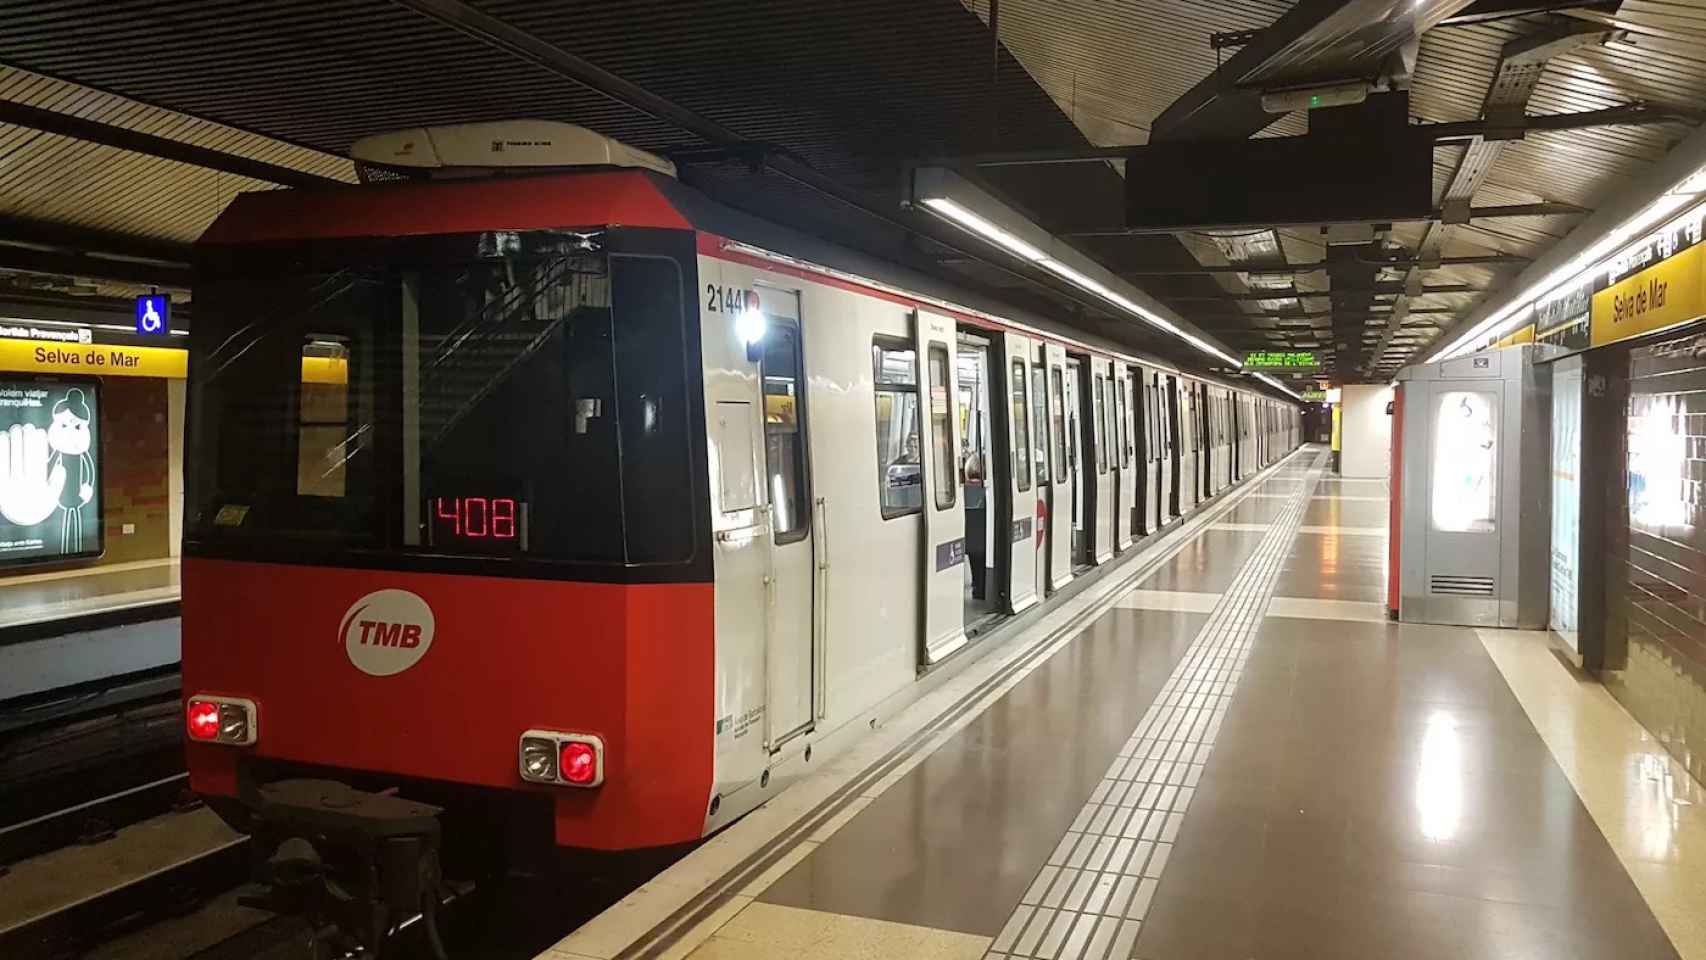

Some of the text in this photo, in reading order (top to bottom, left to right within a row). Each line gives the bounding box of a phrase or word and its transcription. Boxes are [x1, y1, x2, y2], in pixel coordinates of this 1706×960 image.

[707, 284, 742, 314] 2144
[1613, 291, 1633, 323] Selva
[1636, 284, 1647, 314] de
[1650, 277, 1668, 311] Mar
[34, 346, 140, 368] Selva de Mar
[437, 497, 514, 537] 408
[359, 620, 422, 649] TMB
